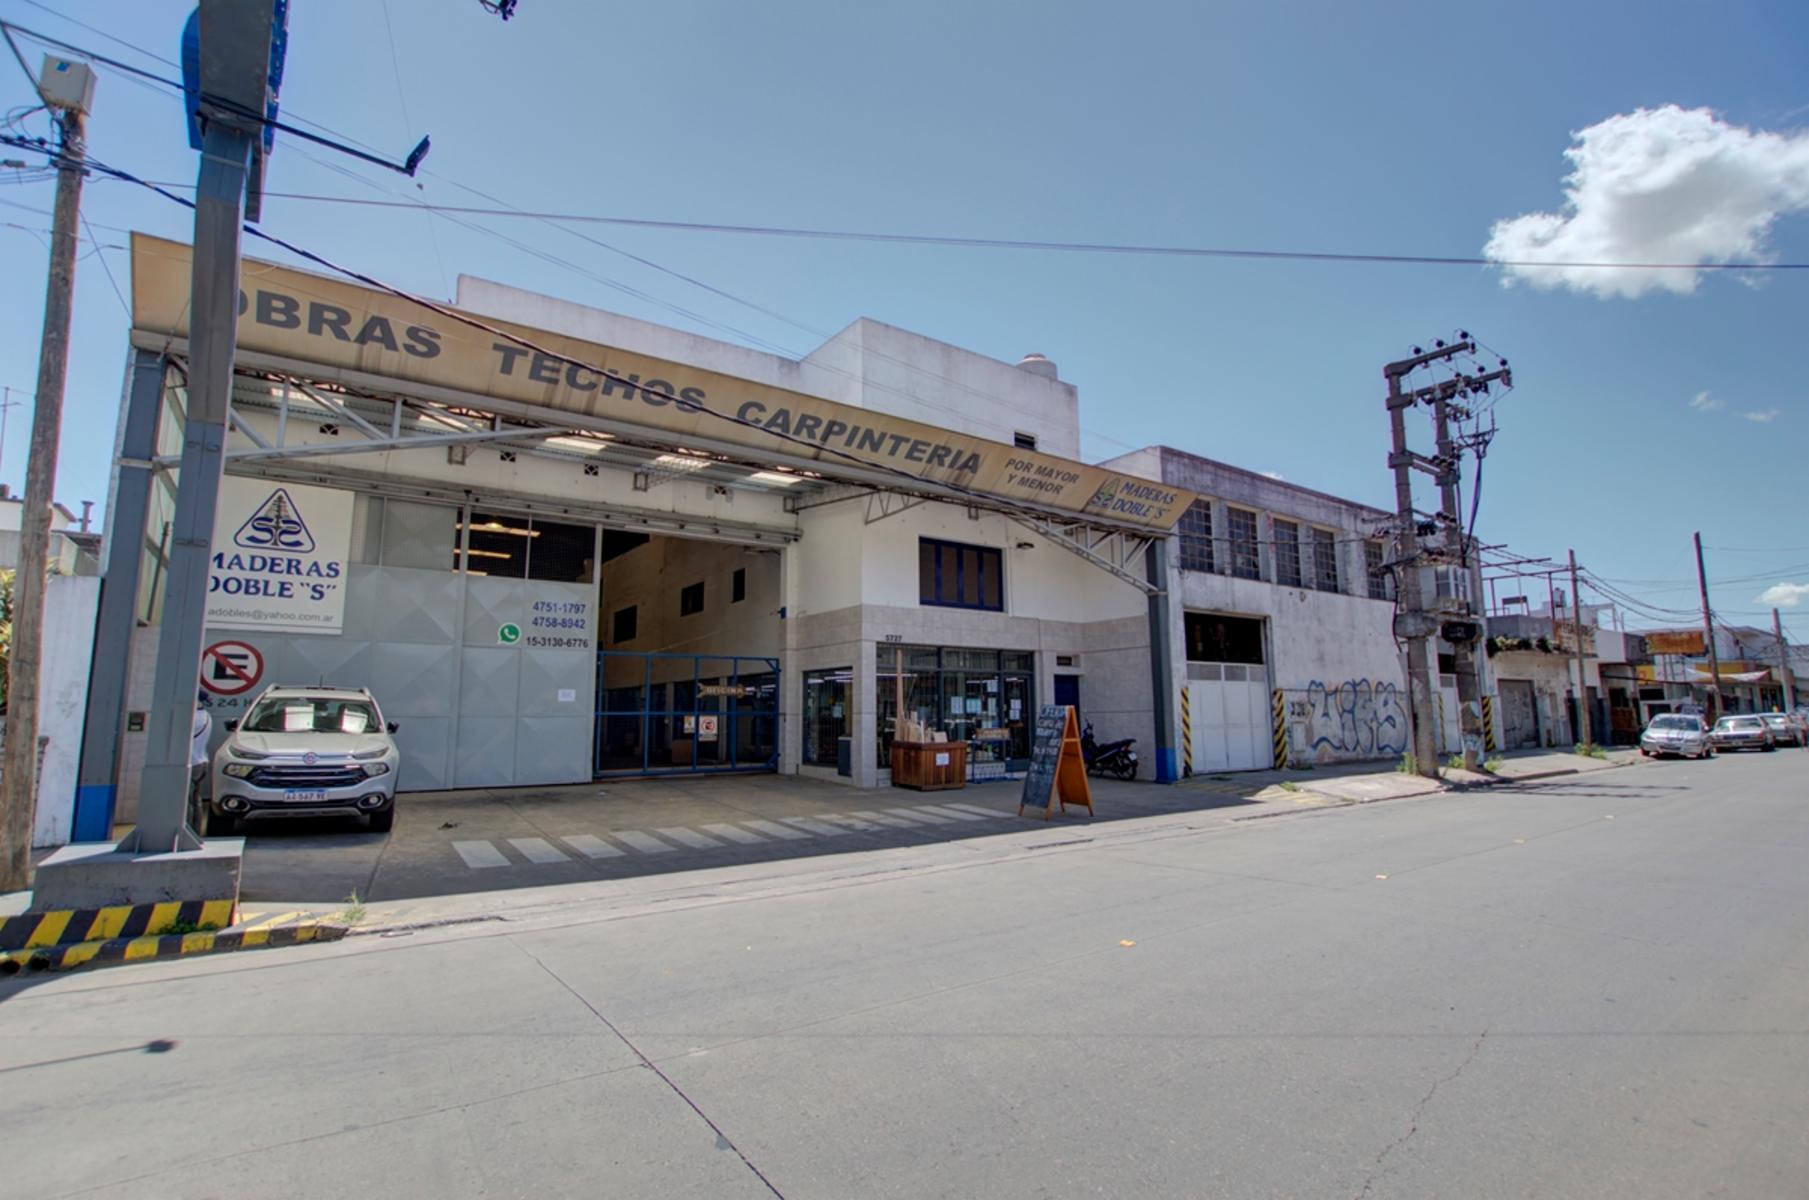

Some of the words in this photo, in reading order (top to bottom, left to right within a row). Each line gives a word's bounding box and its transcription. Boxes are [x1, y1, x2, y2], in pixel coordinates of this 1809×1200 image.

[493, 343, 706, 413] TECHOS
[737, 401, 982, 474] CARPINTERIA
[1005, 458, 1033, 473] POR
[1036, 465, 1080, 484] MAYOR
[1006, 473, 1019, 484] Y
[1019, 475, 1063, 495] MENOR
[1121, 482, 1177, 504] MADERAS
[1112, 498, 1150, 519] DOBLE
[532, 601, 587, 614] 4751-1797
[531, 616, 586, 629] 4758-8942
[526, 636, 589, 648] 15-3130-6776
